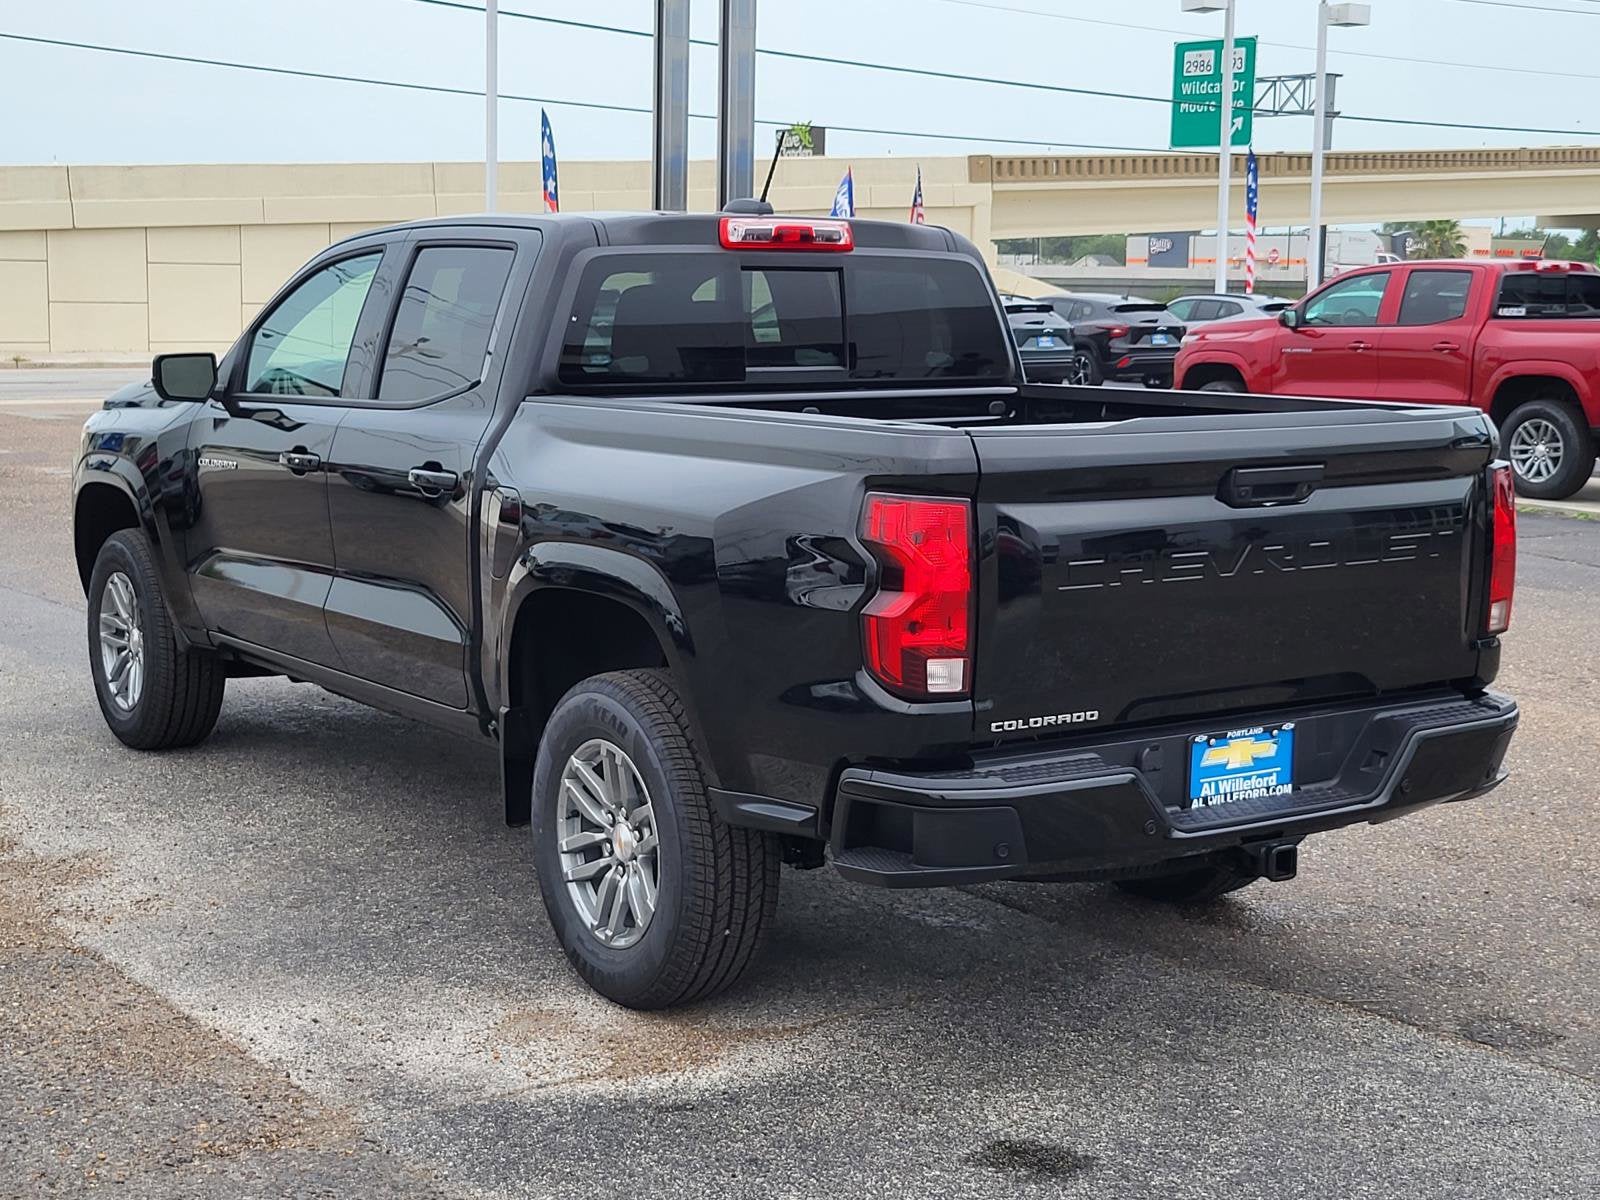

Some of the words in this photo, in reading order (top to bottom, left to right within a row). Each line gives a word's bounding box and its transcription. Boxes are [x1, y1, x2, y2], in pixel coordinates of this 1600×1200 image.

[1185, 58, 1212, 74] 2986
[1181, 81, 1222, 95] Wildca
[1231, 79, 1246, 93] Dr
[1057, 530, 1454, 591] CHEVROLET
[990, 710, 1099, 732] COLORADO
[1226, 727, 1264, 739] PORTLAND
[1200, 782, 1216, 797] Al
[1218, 772, 1277, 795] Willeford
